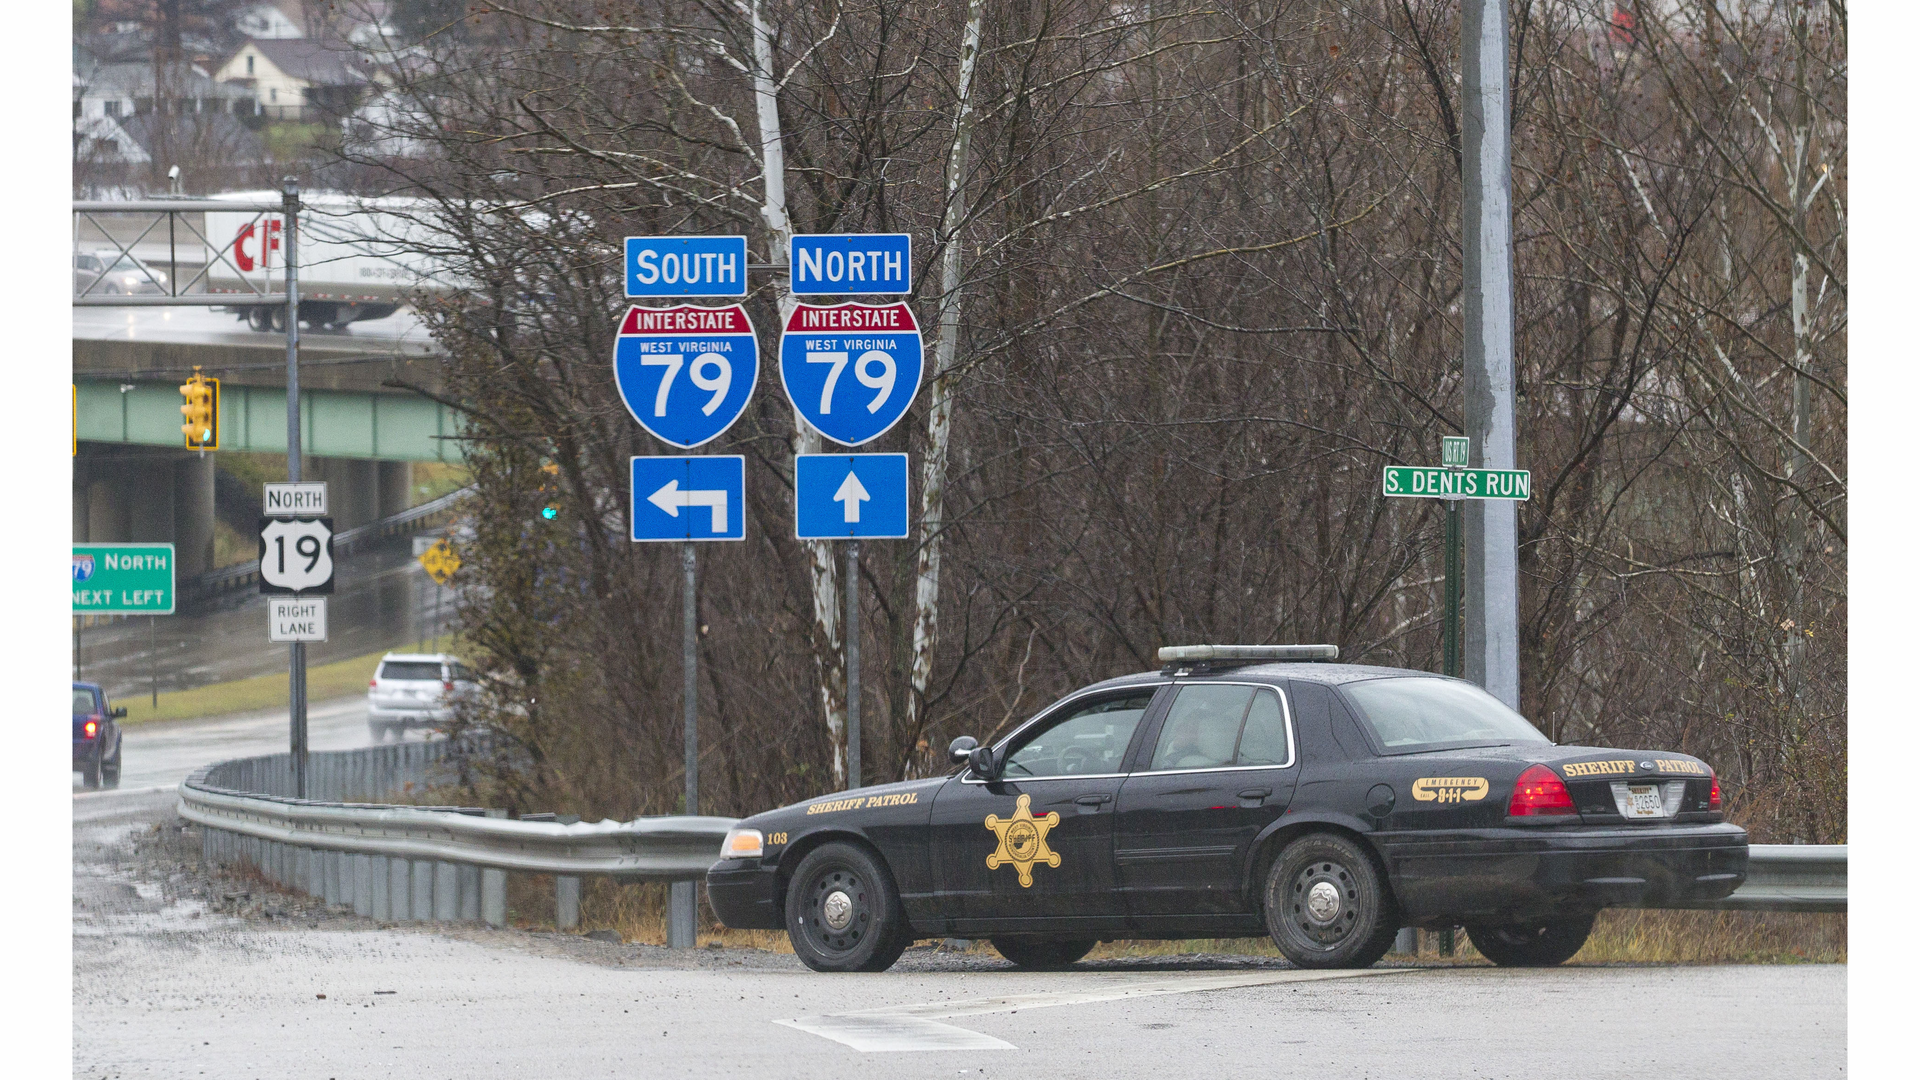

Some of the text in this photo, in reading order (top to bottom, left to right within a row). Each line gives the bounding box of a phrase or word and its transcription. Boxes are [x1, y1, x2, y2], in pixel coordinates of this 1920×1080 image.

[636, 249, 736, 285] SOUTH
[799, 247, 902, 282] NORTH
[637, 312, 735, 330] INTERSTATE
[802, 309, 900, 328] INTERSTATE
[640, 341, 732, 353] WEST VIRGINIA
[805, 338, 897, 350] WEST VIRGINIA
[640, 353, 733, 417] 79
[806, 350, 897, 415] 79
[1386, 470, 1528, 496] S. DENTS RUN
[268, 490, 322, 508] NORTH
[275, 535, 321, 575] 19
[72, 553, 167, 578] 79 NORTH
[72, 589, 164, 605] NEXT LEFT
[278, 604, 316, 618] RIGHT
[280, 622, 316, 635] LANE
[1562, 759, 1705, 777] SHERIFF PATROL
[806, 792, 918, 815] SHERIFF PATROL
[767, 832, 788, 845] 103
